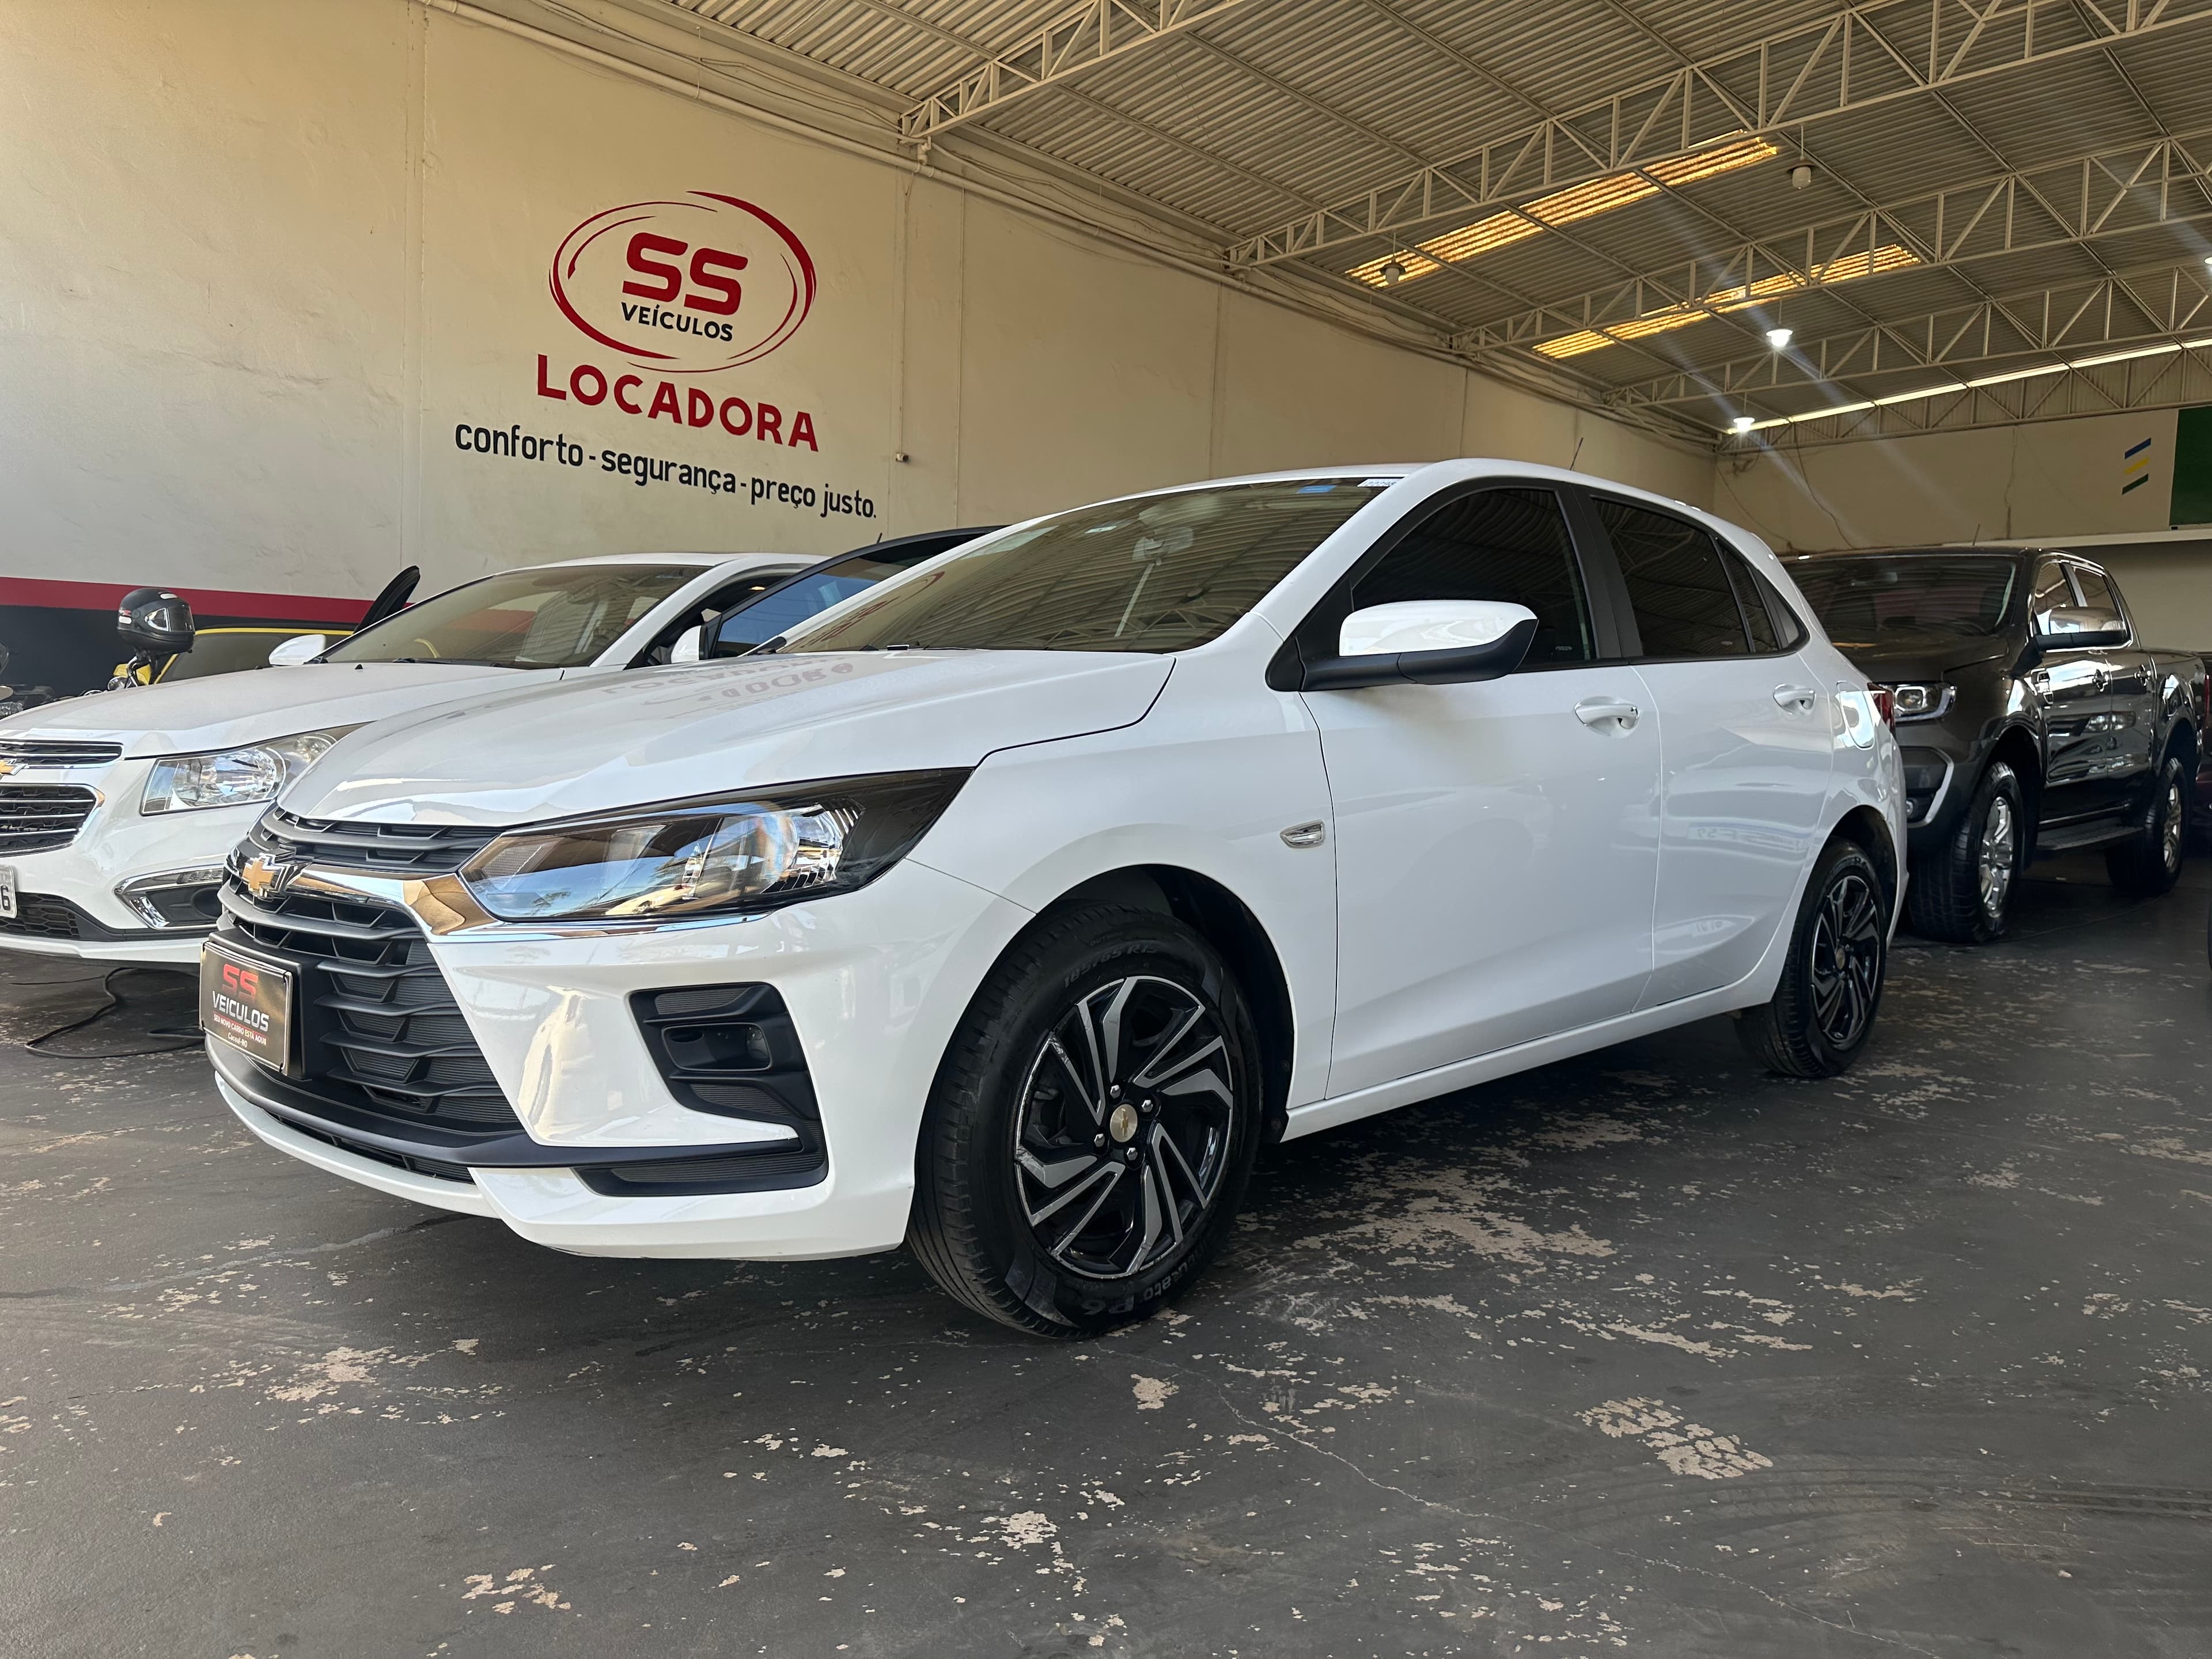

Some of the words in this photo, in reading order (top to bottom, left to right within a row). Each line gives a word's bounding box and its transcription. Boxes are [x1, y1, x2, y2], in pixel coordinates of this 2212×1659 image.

[623, 232, 748, 315] SS
[622, 302, 733, 342] VEÍCULOS
[538, 354, 817, 451] LOCADORA
[455, 424, 583, 467] conforto
[601, 450, 736, 495] segurança
[751, 478, 816, 509] preço
[820, 483, 877, 518] justo.
[0, 884, 10, 910] 6
[221, 964, 259, 1003] SS
[213, 990, 270, 1032] VEICULOS
[221, 1018, 231, 1029] NOVO
[231, 1022, 244, 1035] CARRO
[245, 1029, 255, 1040] ESTÁ
